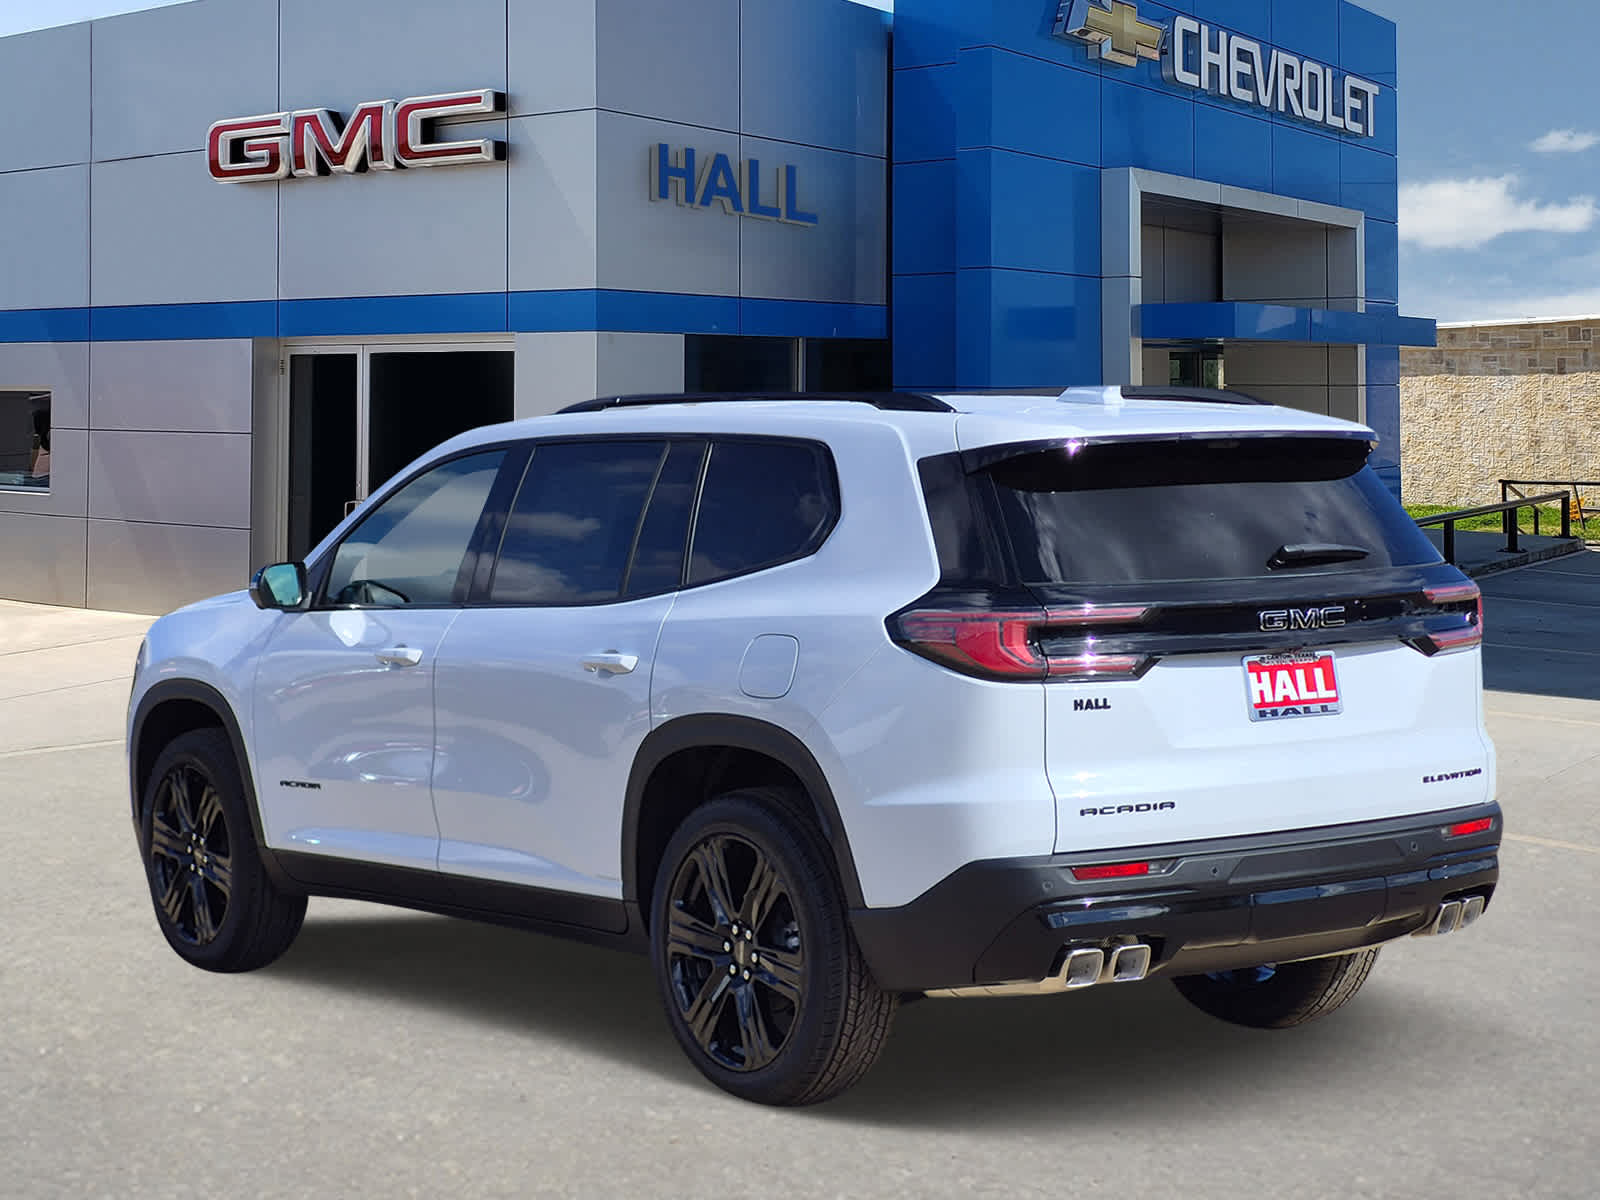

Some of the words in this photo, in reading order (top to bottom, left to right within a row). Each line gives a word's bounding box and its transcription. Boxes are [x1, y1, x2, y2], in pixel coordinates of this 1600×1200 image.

[1173, 15, 1379, 137] CHEVROLET
[207, 88, 507, 184] GMC
[651, 143, 818, 226] HALL
[1260, 606, 1346, 632] GMC
[1248, 667, 1337, 704] HALL
[1073, 698, 1111, 711] HALL
[1258, 704, 1338, 718] HALL
[280, 780, 321, 790] ACADIA
[1080, 801, 1176, 817] ACADIA
